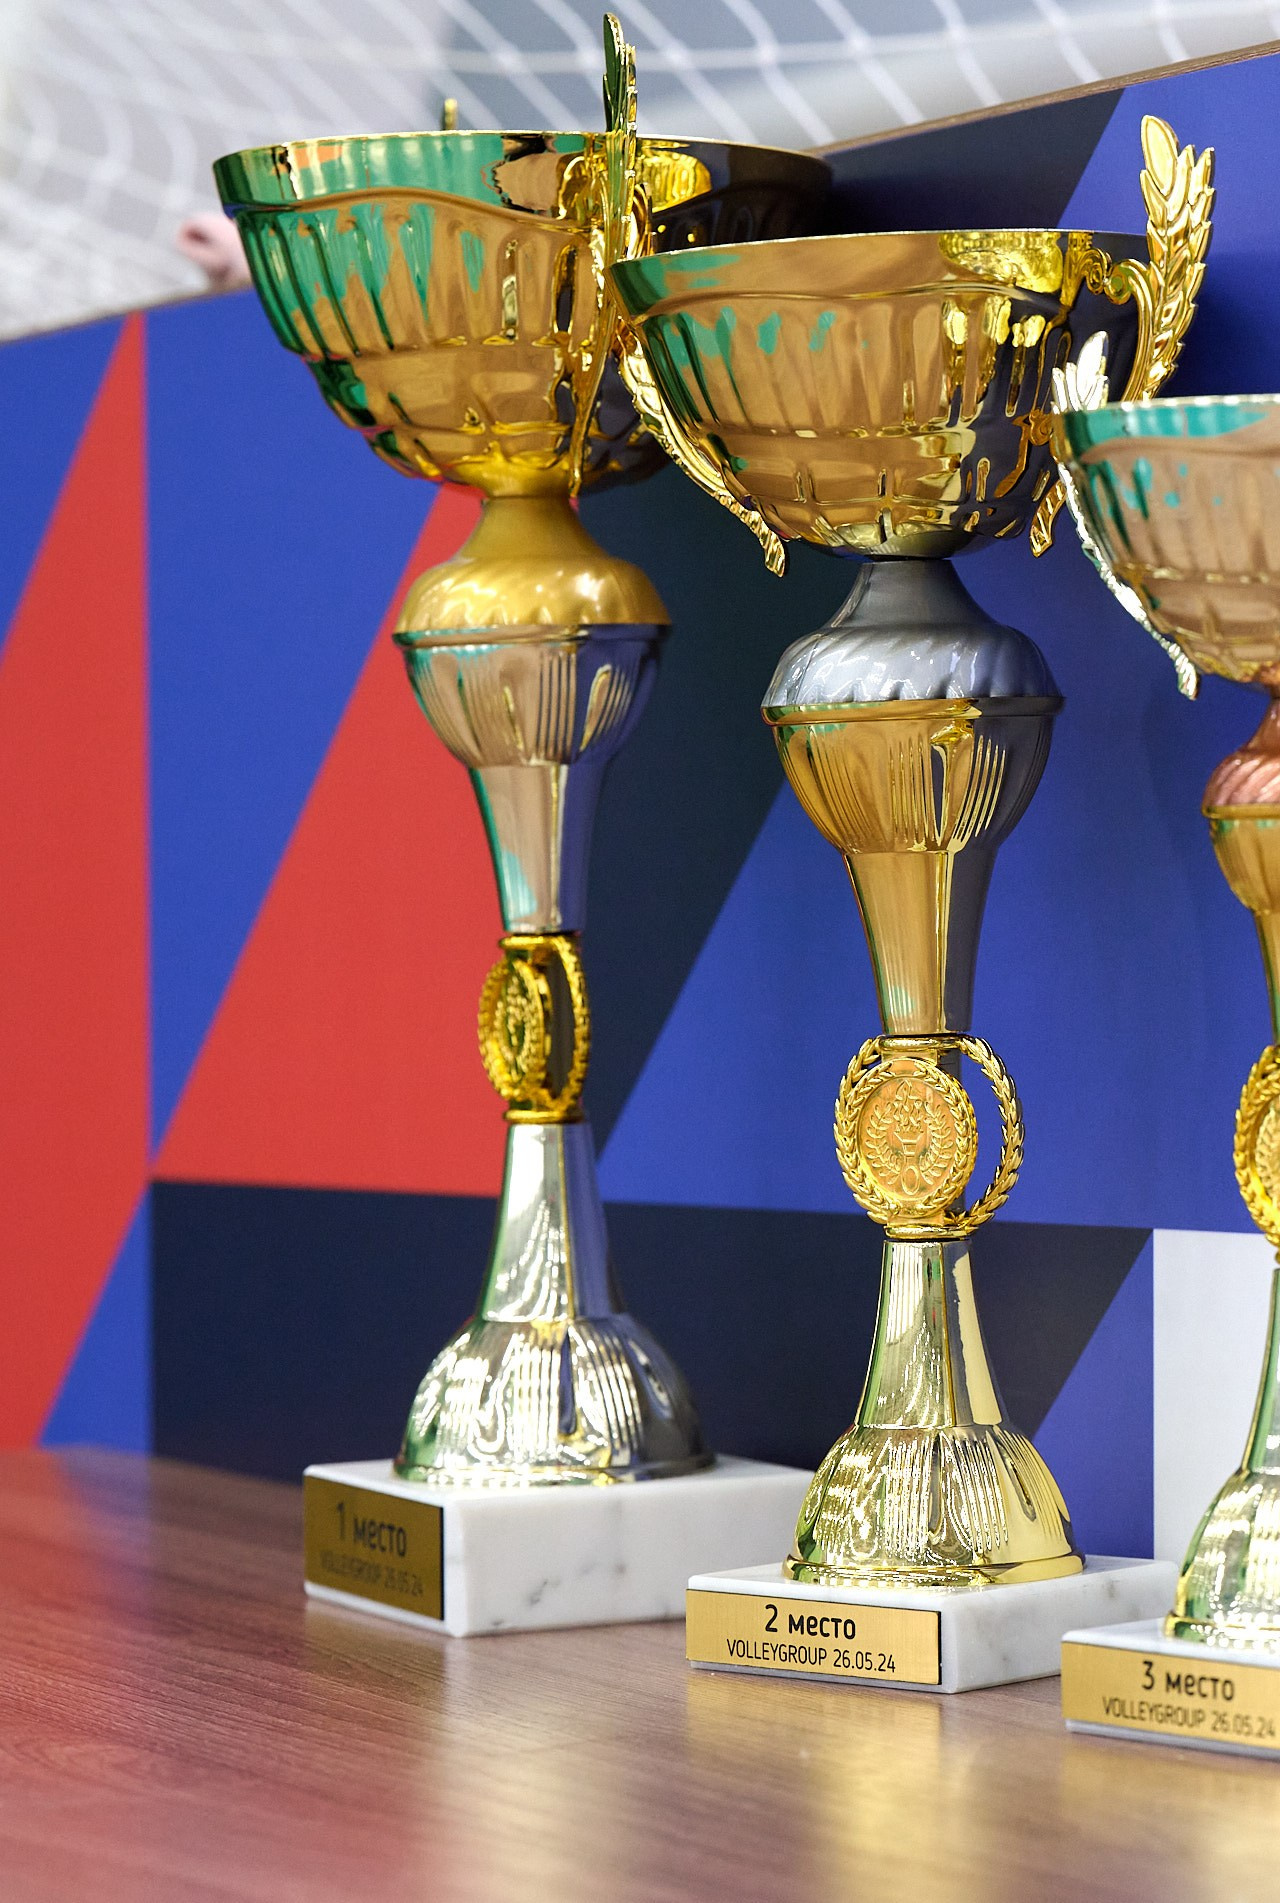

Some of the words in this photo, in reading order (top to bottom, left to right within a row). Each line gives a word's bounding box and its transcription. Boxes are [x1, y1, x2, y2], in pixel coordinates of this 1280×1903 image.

[336, 1501, 346, 1541] 1
[352, 1515, 408, 1558] место
[764, 1603, 779, 1633] 2
[788, 1613, 857, 1640] место
[726, 1638, 828, 1666] VOLLEYGROUP
[832, 1648, 896, 1673] 26.05.24
[1141, 1660, 1155, 1690] 3
[1165, 1671, 1236, 1701] место
[1102, 1696, 1206, 1729] VOLLEYGROUP
[1210, 1710, 1276, 1738] 26.05.24
